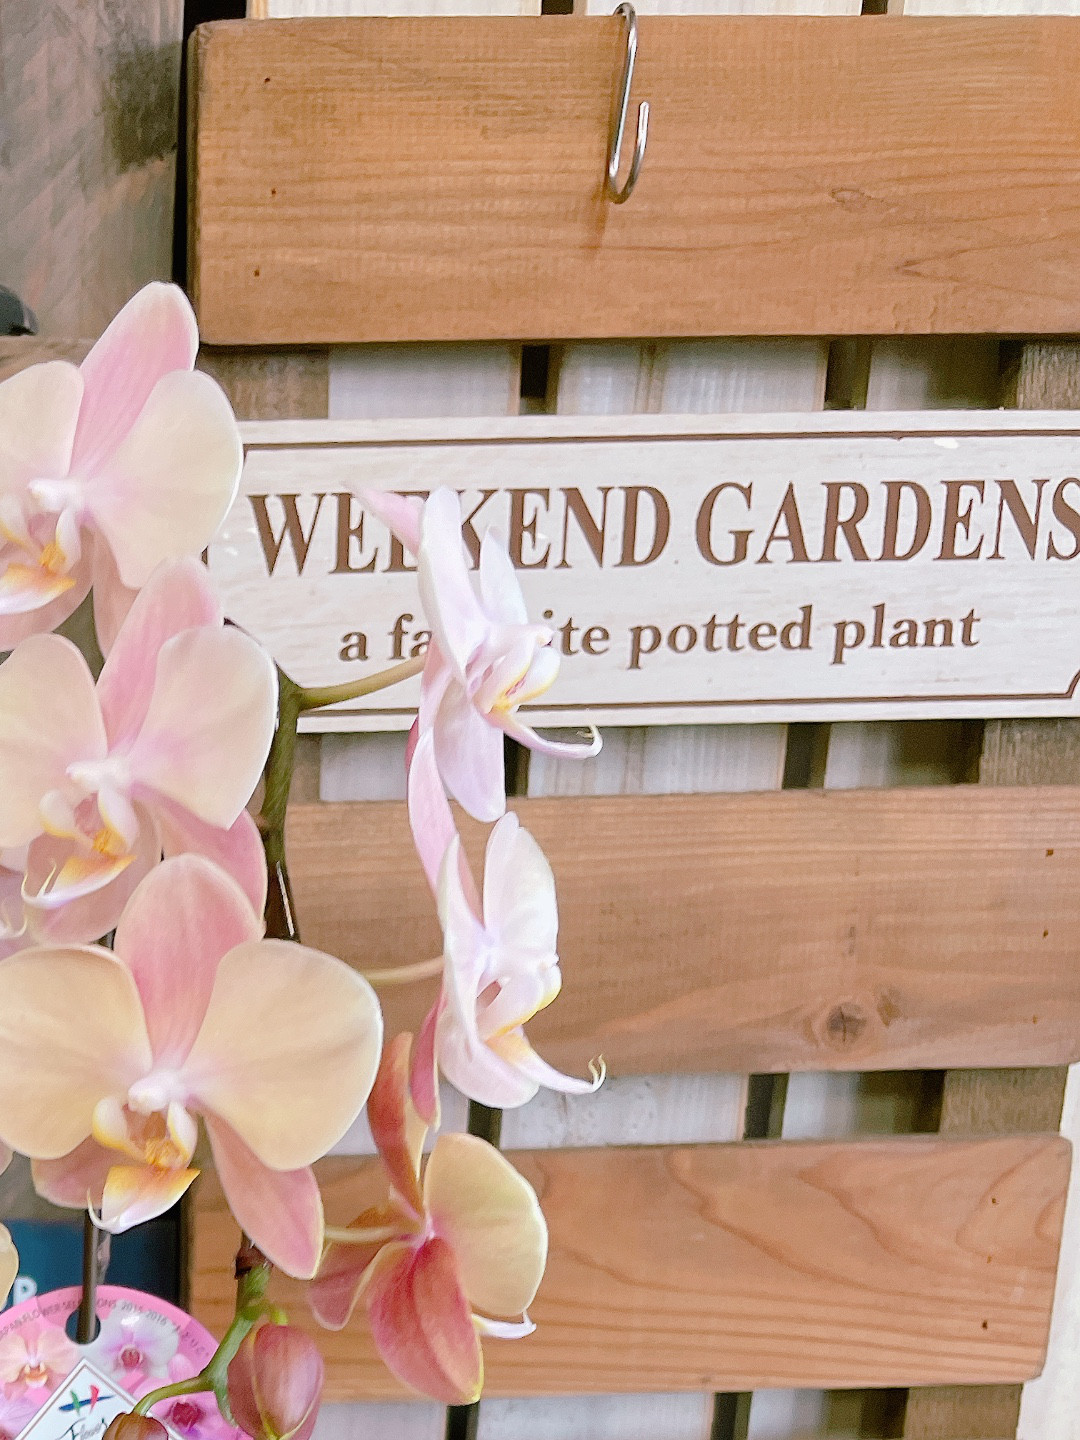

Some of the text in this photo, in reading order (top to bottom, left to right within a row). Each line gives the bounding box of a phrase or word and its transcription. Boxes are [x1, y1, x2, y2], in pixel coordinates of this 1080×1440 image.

[695, 477, 1080, 567] GARDENS
[338, 629, 369, 663] a
[627, 603, 814, 670] potted
[829, 602, 981, 666] plant
